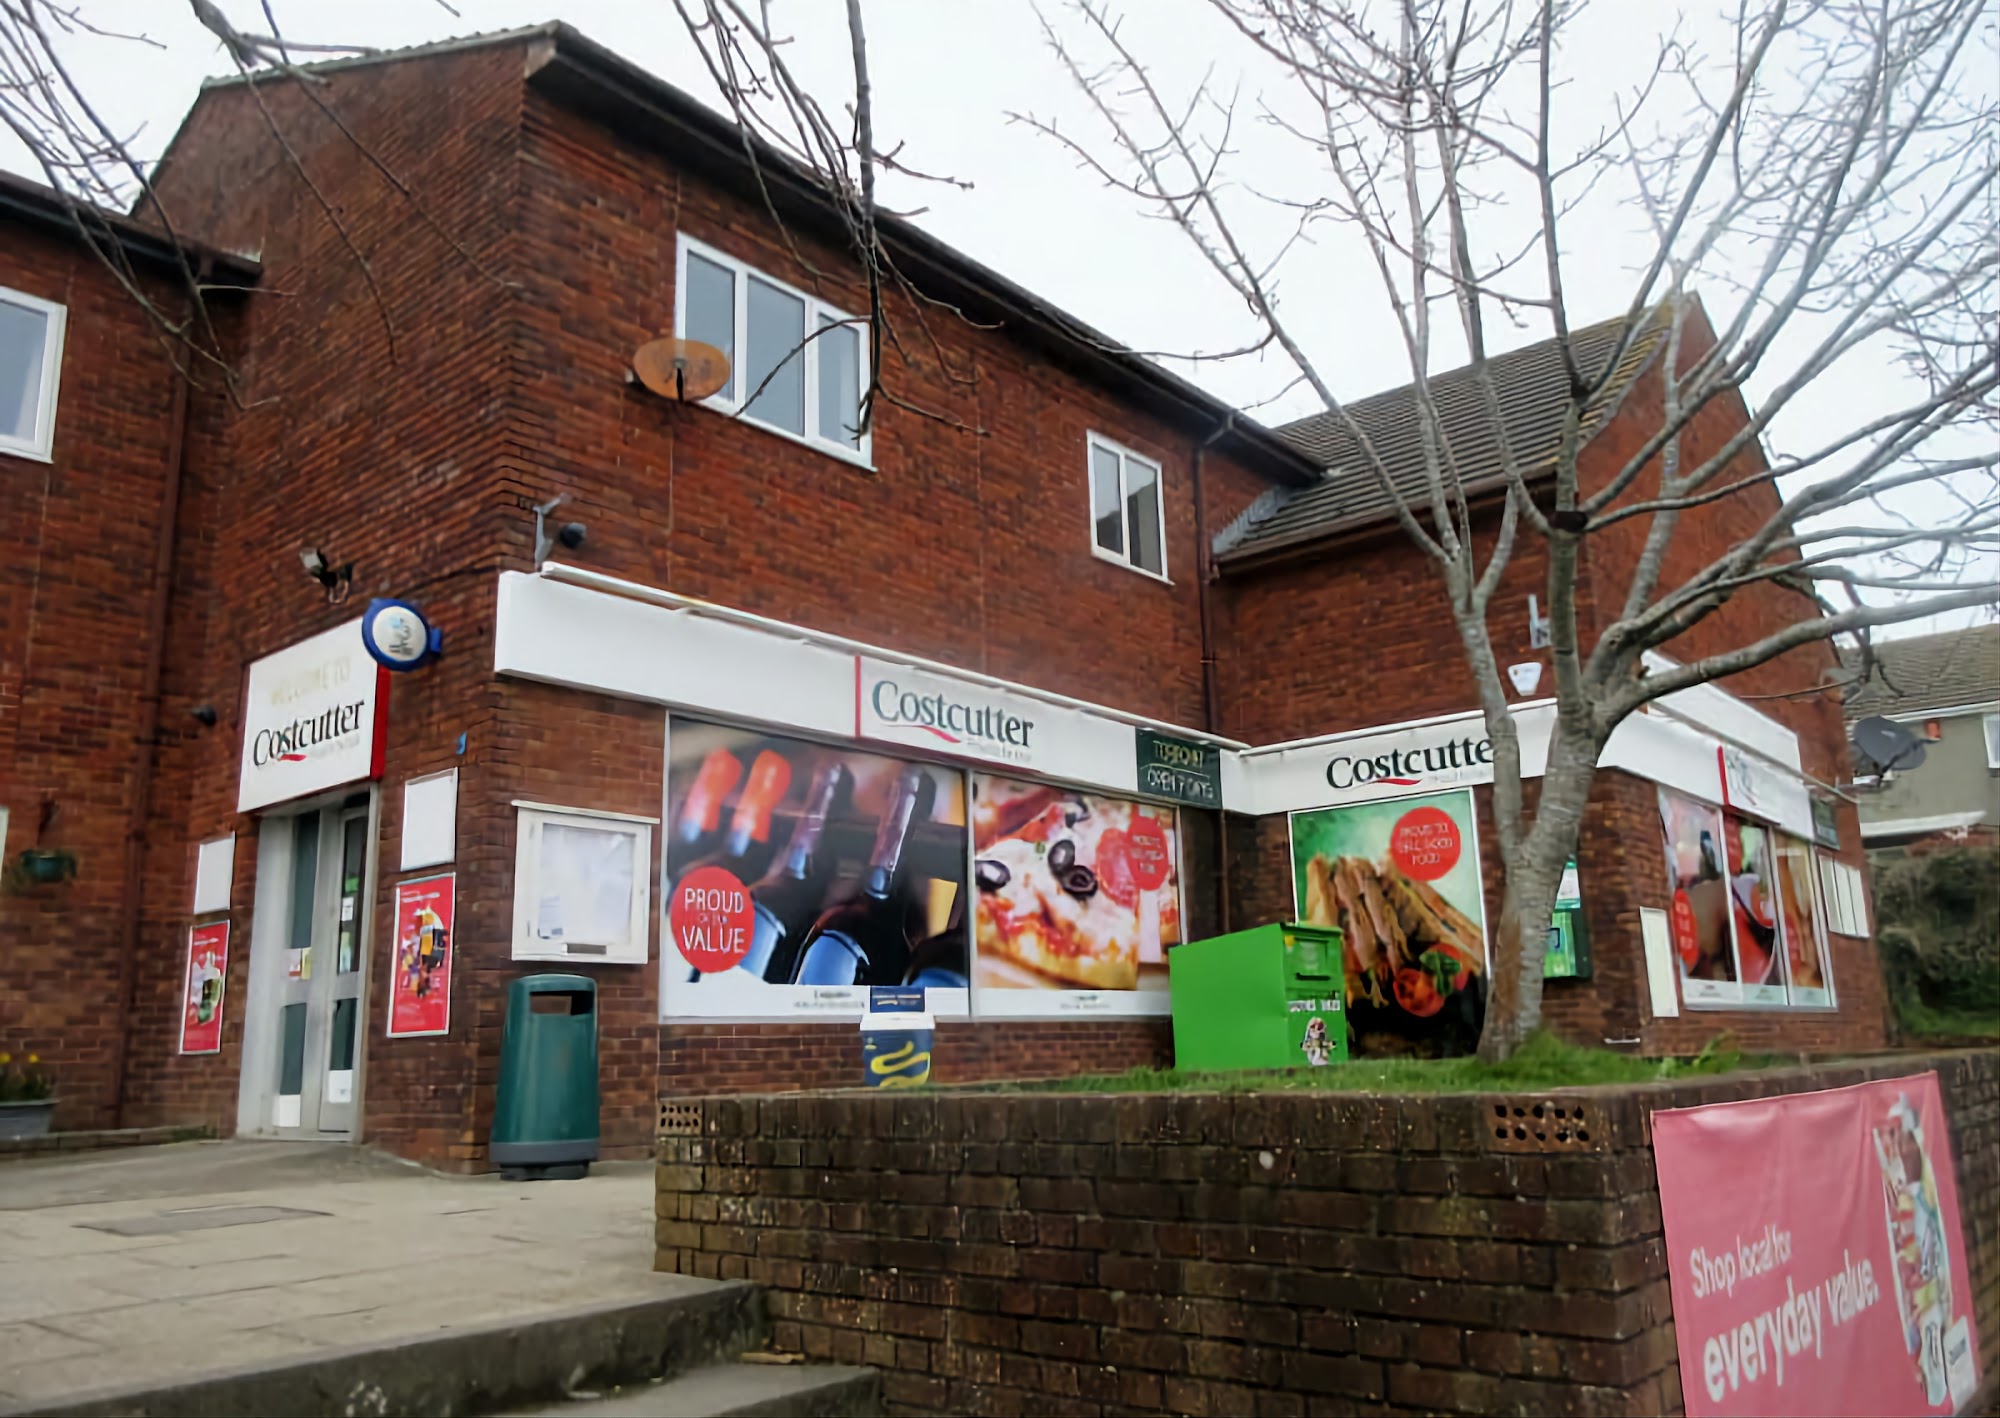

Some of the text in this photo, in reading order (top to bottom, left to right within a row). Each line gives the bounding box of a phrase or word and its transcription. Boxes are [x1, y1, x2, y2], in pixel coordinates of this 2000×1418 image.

[253, 699, 365, 768] Costcutter
[871, 680, 1034, 747] Costcutter
[1326, 738, 1494, 789] Costcutte
[684, 887, 744, 914] PROUD
[682, 925, 745, 955] VALUE
[1690, 1245, 1735, 1299] Shop
[1704, 1274, 1822, 1403] everyday
